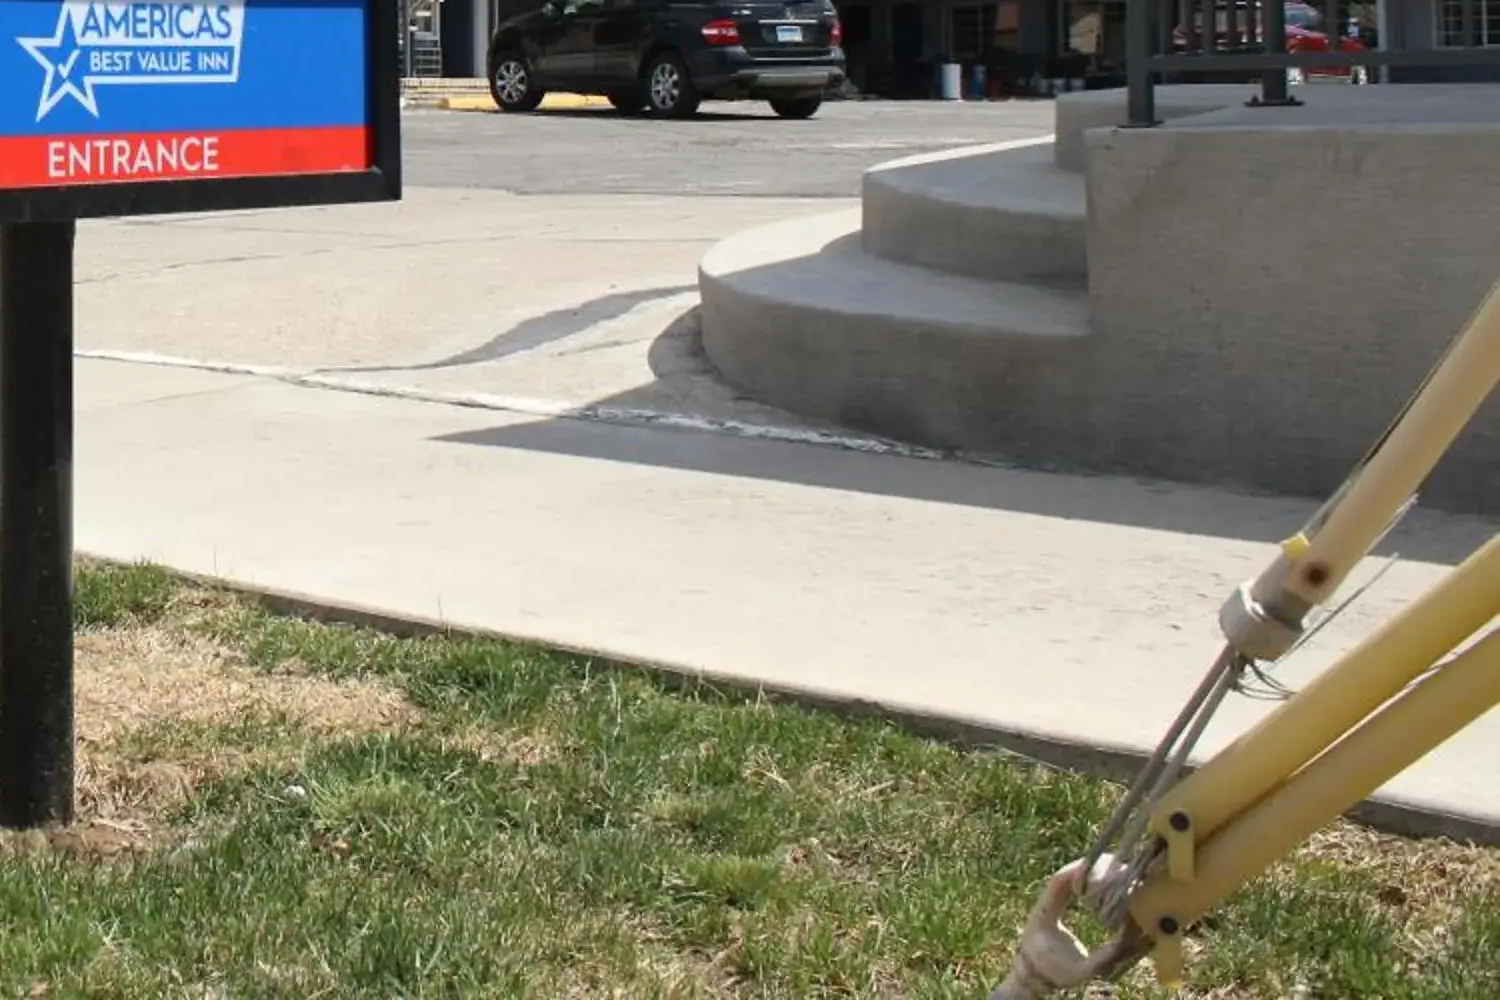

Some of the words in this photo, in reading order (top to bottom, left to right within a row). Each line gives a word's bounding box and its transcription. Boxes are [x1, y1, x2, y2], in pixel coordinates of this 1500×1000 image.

[80, 2, 233, 40] AMERICAS
[90, 50, 133, 72] BEST
[137, 50, 193, 72] VALUE
[198, 50, 229, 71] INN
[48, 136, 220, 178] ENTRANCE
